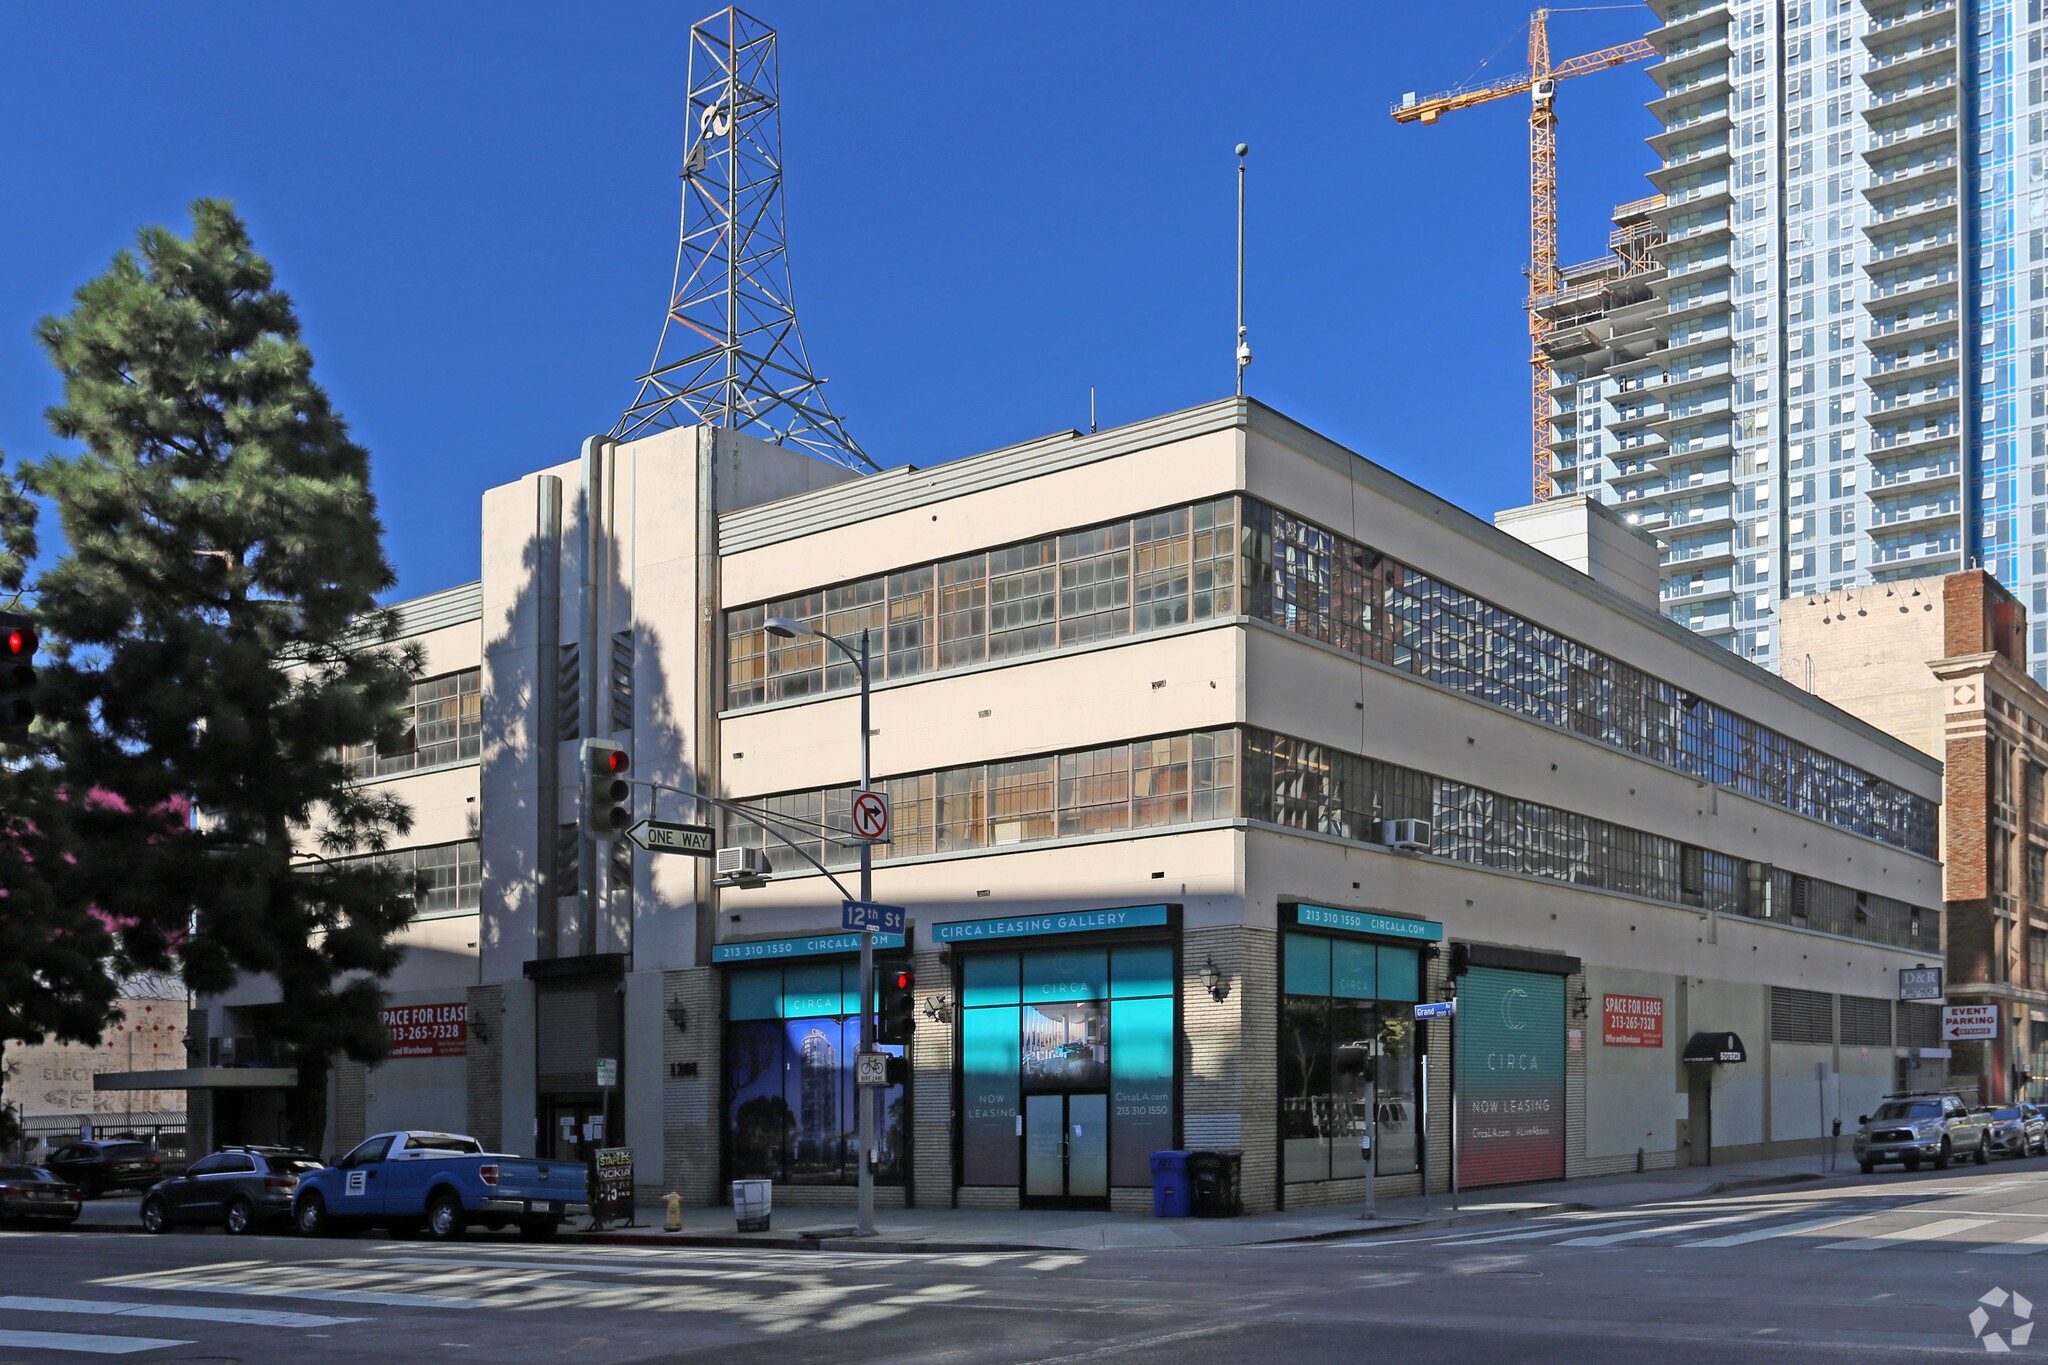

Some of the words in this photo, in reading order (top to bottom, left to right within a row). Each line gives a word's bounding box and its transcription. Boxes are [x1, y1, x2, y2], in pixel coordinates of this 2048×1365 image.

[648, 829, 674, 845] ONE
[682, 832, 708, 848] WAY
[848, 906, 878, 926] 12th
[885, 912, 901, 927] St
[1306, 910, 1320, 921] 213
[1323, 912, 1338, 923] 310
[1341, 914, 1361, 926] 1550
[1371, 919, 1425, 934] CIRCALA.COM
[941, 925, 982, 938] CIRCA
[989, 919, 1051, 934] LEASING
[1058, 912, 1126, 928] GALLERY
[724, 947, 741, 957] 213
[745, 946, 763, 956] 310
[767, 943, 792, 953] 1550
[807, 935, 889, 950] CIRCALA.OM
[1904, 971, 1937, 984] D&R
[1042, 982, 1088, 994] CIRCA
[793, 999, 832, 1010] CIRCA
[1605, 998, 1627, 1013] SPACE
[1628, 999, 1641, 1014] FOR
[1643, 1001, 1661, 1016] LEASE
[412, 1008, 433, 1024] FOR
[1417, 1007, 1434, 1017] Grand
[1952, 1007, 1988, 1016] EVENT
[1611, 1015, 1656, 1030] 213-265-7328
[1946, 1016, 1994, 1025] PARKING
[403, 1046, 433, 1054] Warehouse
[1487, 1053, 1539, 1070] CIRCA
[979, 1094, 1005, 1104] NOW
[1116, 1091, 1168, 1102] CircaLA.com
[1116, 1106, 1130, 1115] 213
[1131, 1106, 1146, 1115] 310
[1148, 1105, 1168, 1115] 1550
[1472, 1100, 1499, 1113] NOW
[1503, 1099, 1550, 1113] LEASING
[968, 1108, 1016, 1118] LEASING
[600, 1155, 631, 1166] STAPLES
[600, 1169, 631, 1178] NOKIA
